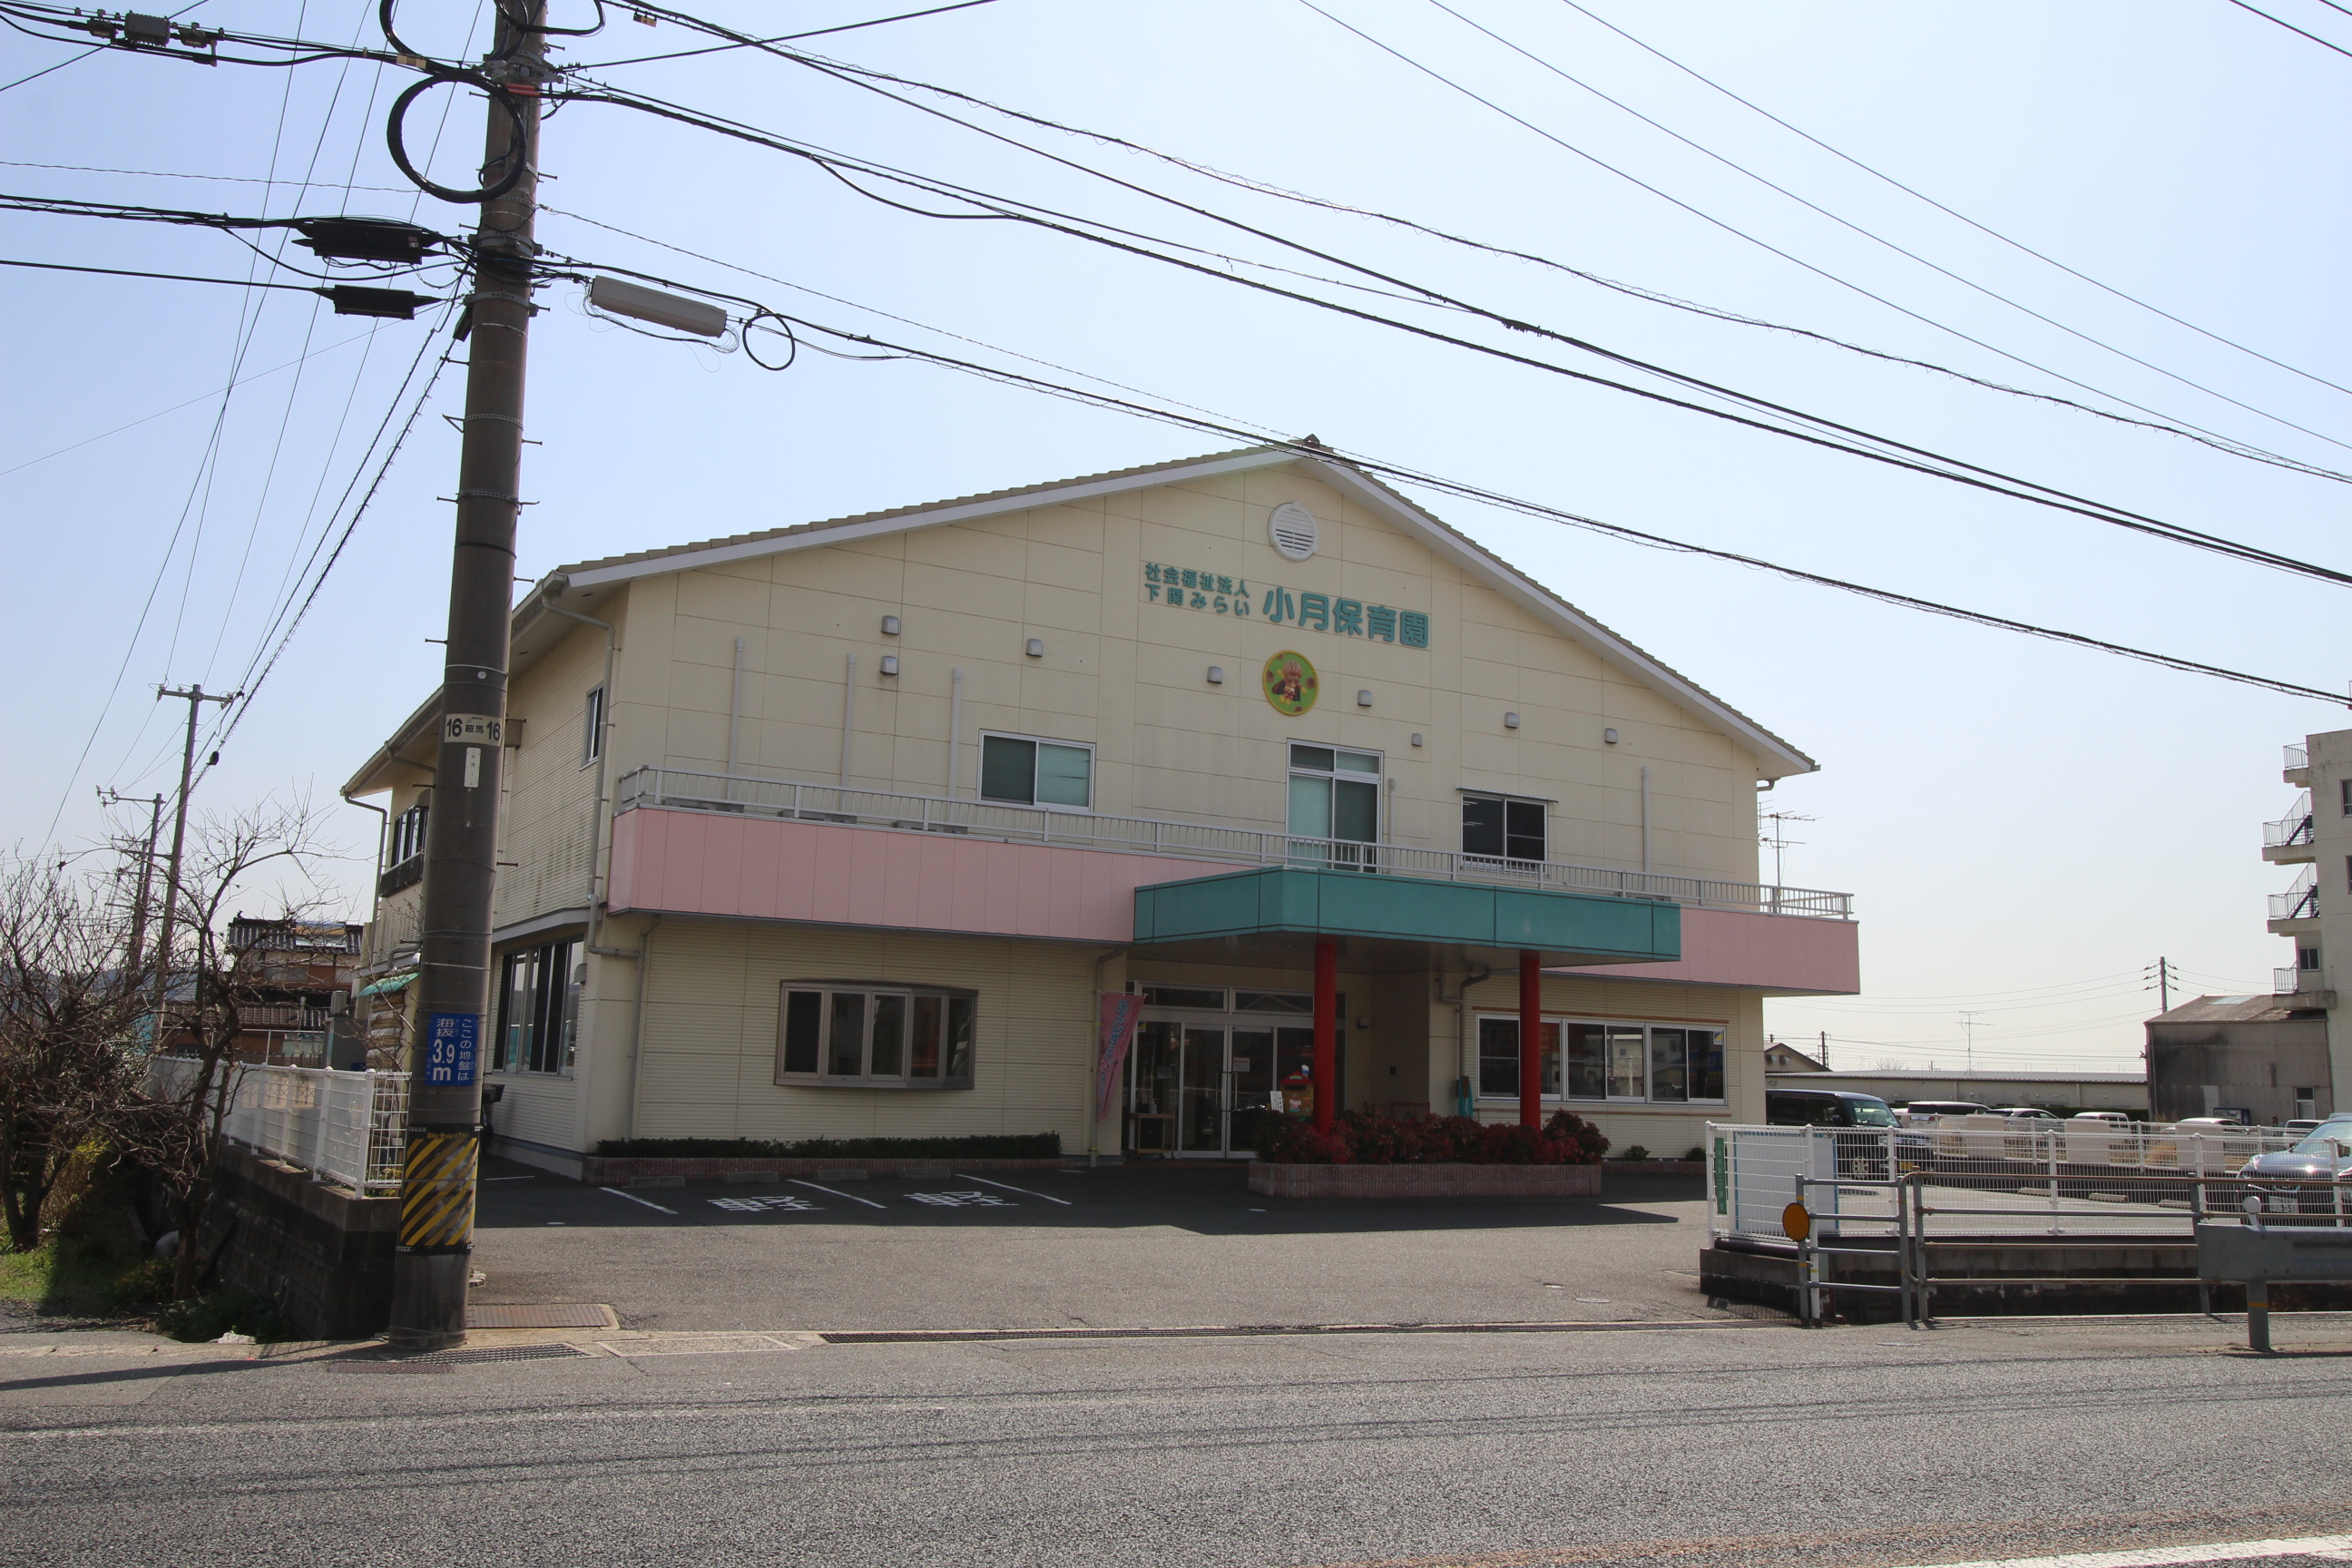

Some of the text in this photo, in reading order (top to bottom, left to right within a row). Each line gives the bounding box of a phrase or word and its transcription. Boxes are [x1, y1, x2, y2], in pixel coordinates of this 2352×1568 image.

[1145, 563, 1250, 598] 社会福祉法人
[1144, 583, 1250, 616] 下関みらい
[1262, 586, 1430, 648] 小月保育園
[446, 718, 463, 738] 16
[486, 720, 501, 741] 16
[436, 1018, 455, 1037] 海抜
[433, 1038, 456, 1063] 3.9
[457, 1019, 473, 1081] ここの地盤は
[433, 1066, 451, 1081] m
